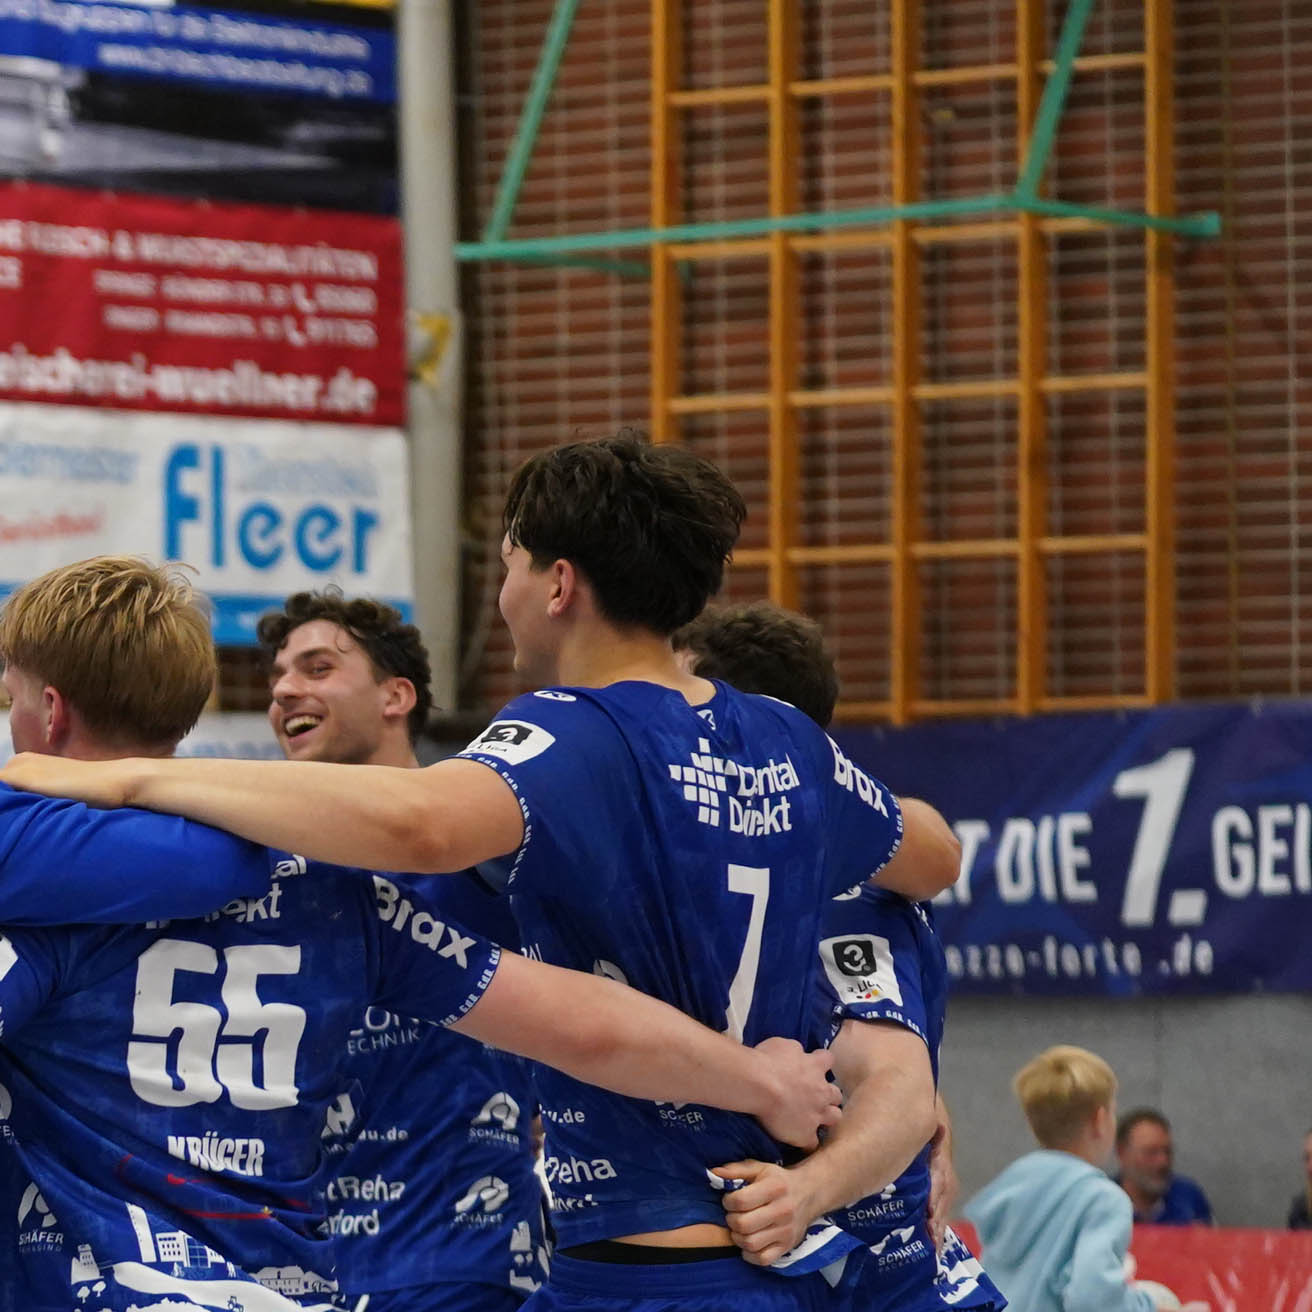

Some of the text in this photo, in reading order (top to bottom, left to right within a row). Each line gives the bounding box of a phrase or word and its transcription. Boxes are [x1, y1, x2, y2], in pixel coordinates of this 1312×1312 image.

[830, 735, 892, 819] Brax
[995, 811, 1098, 903] DIE
[1111, 747, 1208, 928] 1.
[371, 875, 477, 969] Brax
[725, 863, 771, 1046] 7
[847, 1199, 905, 1222] SCHÄFER
[877, 1238, 926, 1267] SCHÄFER
